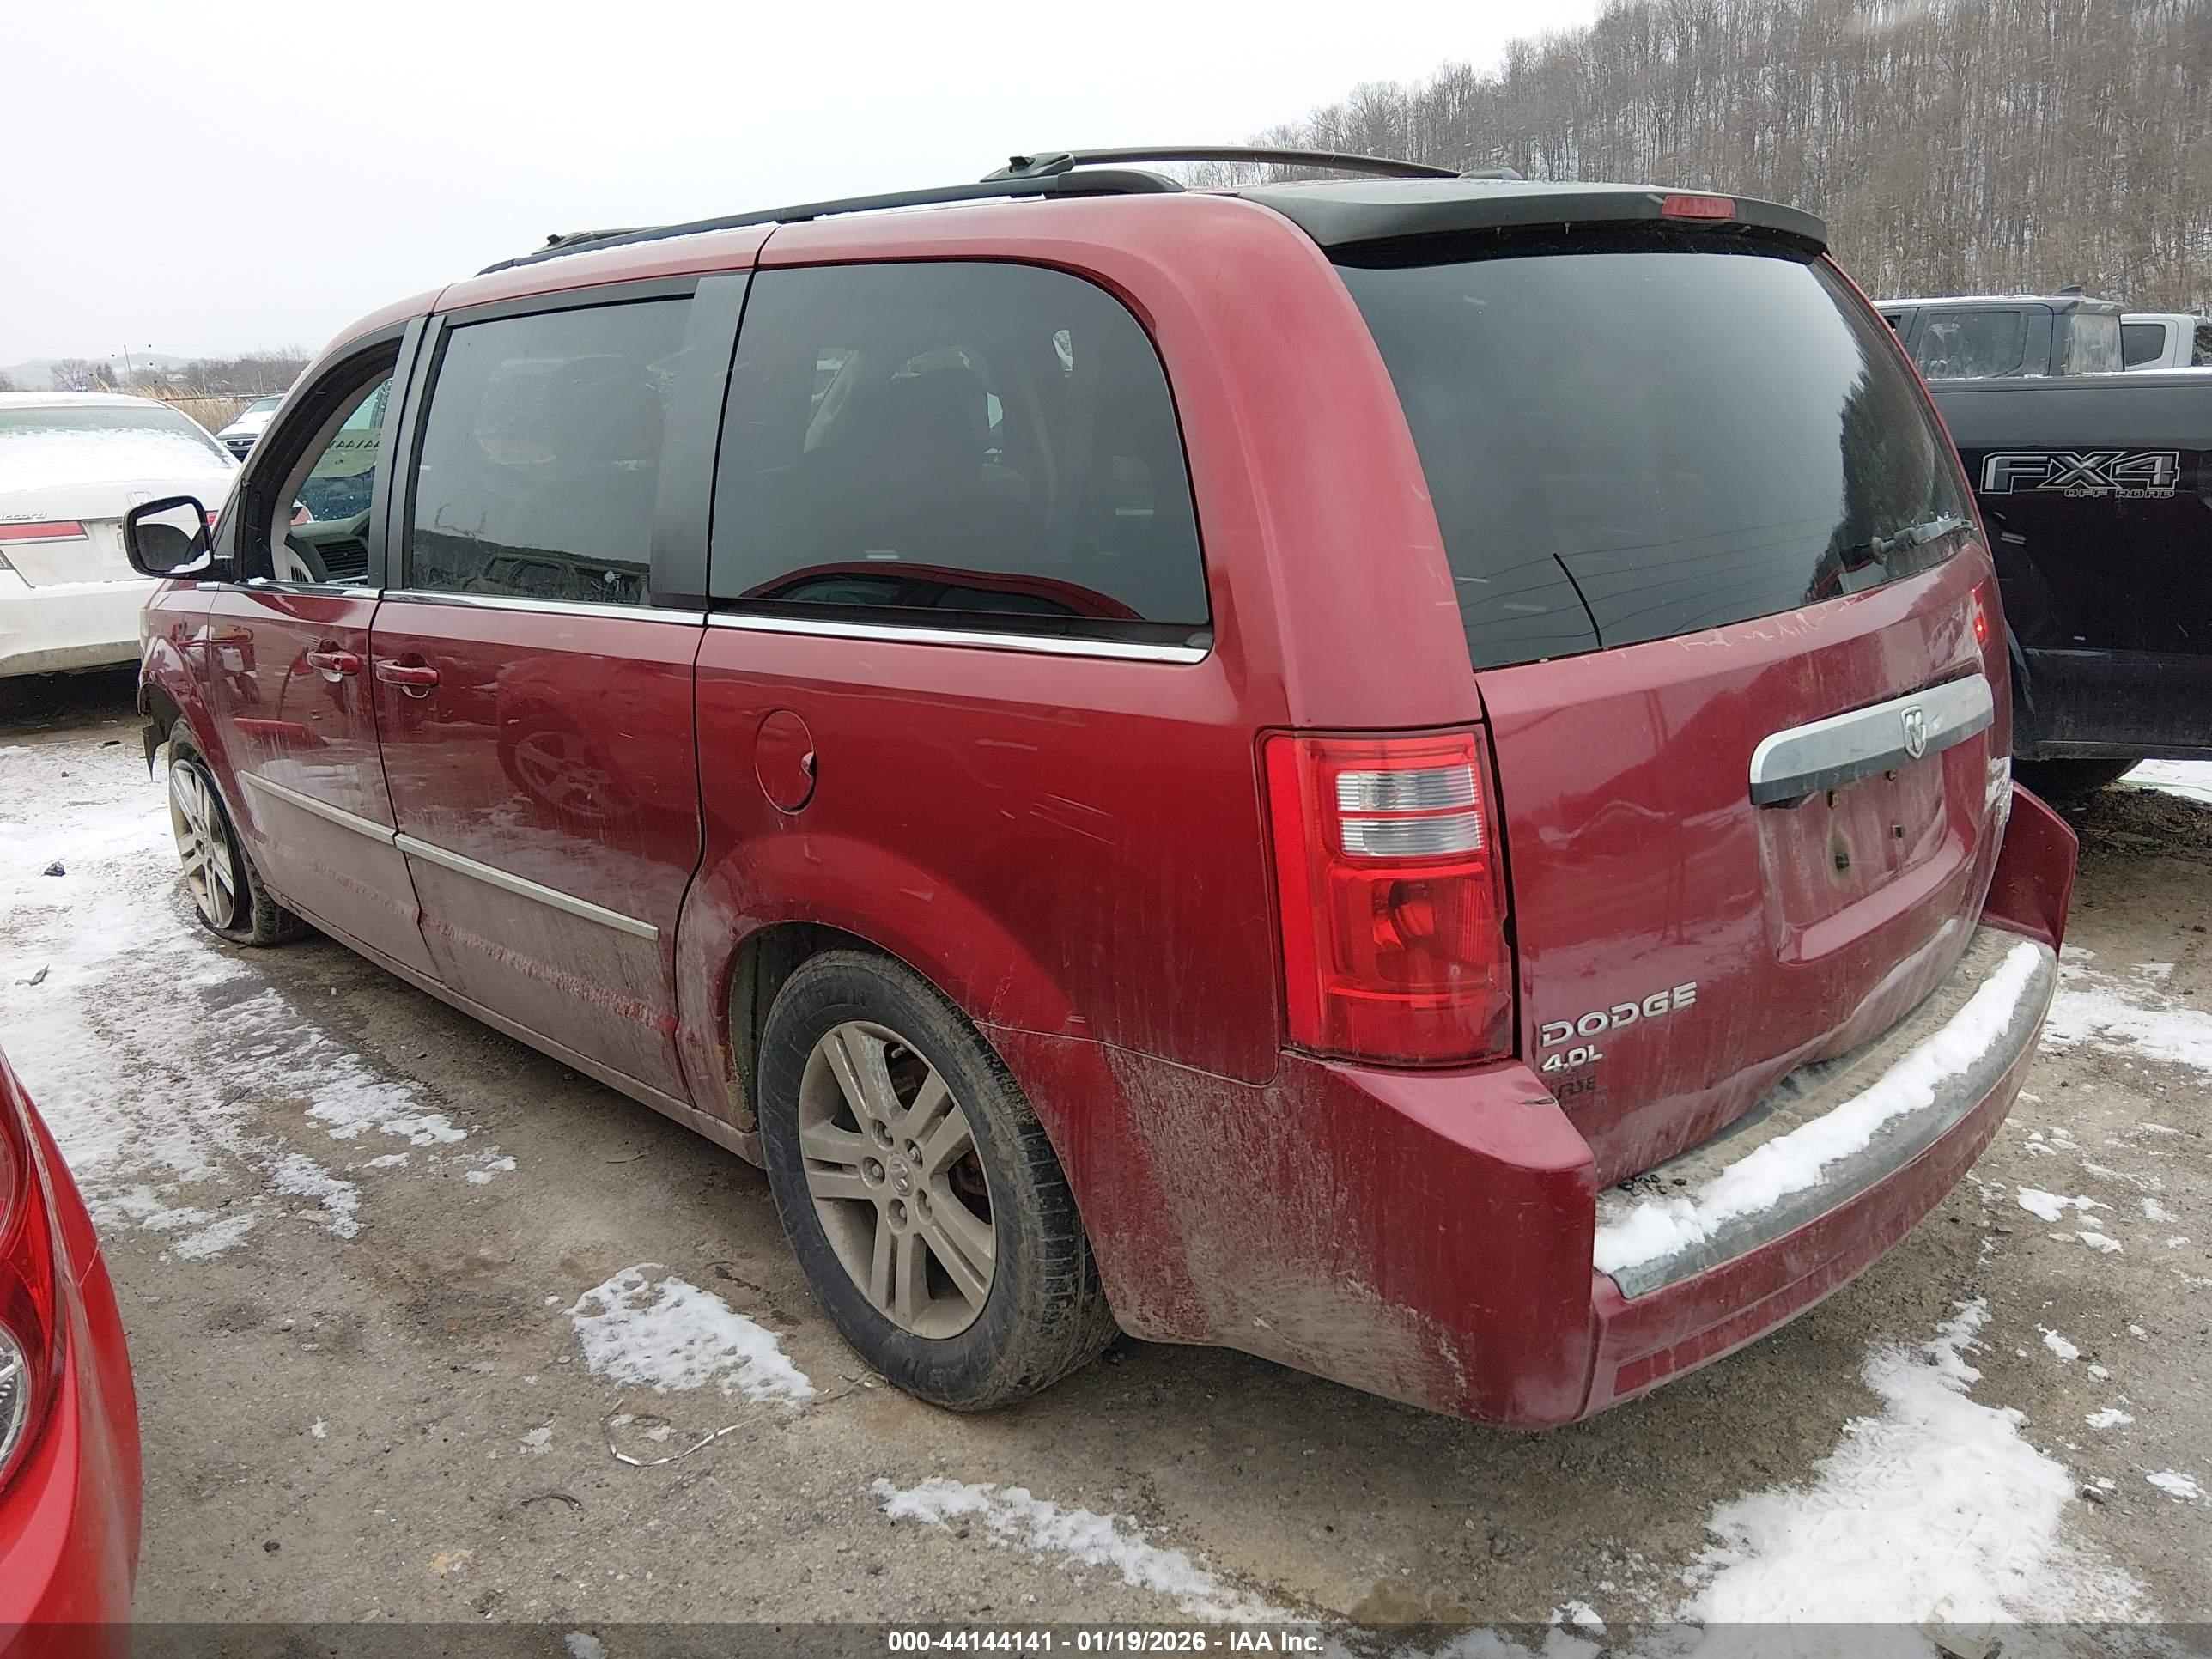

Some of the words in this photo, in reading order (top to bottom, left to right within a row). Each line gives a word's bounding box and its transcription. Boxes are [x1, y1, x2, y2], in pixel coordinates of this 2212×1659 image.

[1980, 451, 2180, 494] FX4
[2063, 488, 2108, 499] OFF
[2114, 489, 2176, 499] ROAD
[1541, 981, 1698, 1048] DODGE
[1541, 1043, 1604, 1073] 4.0L
